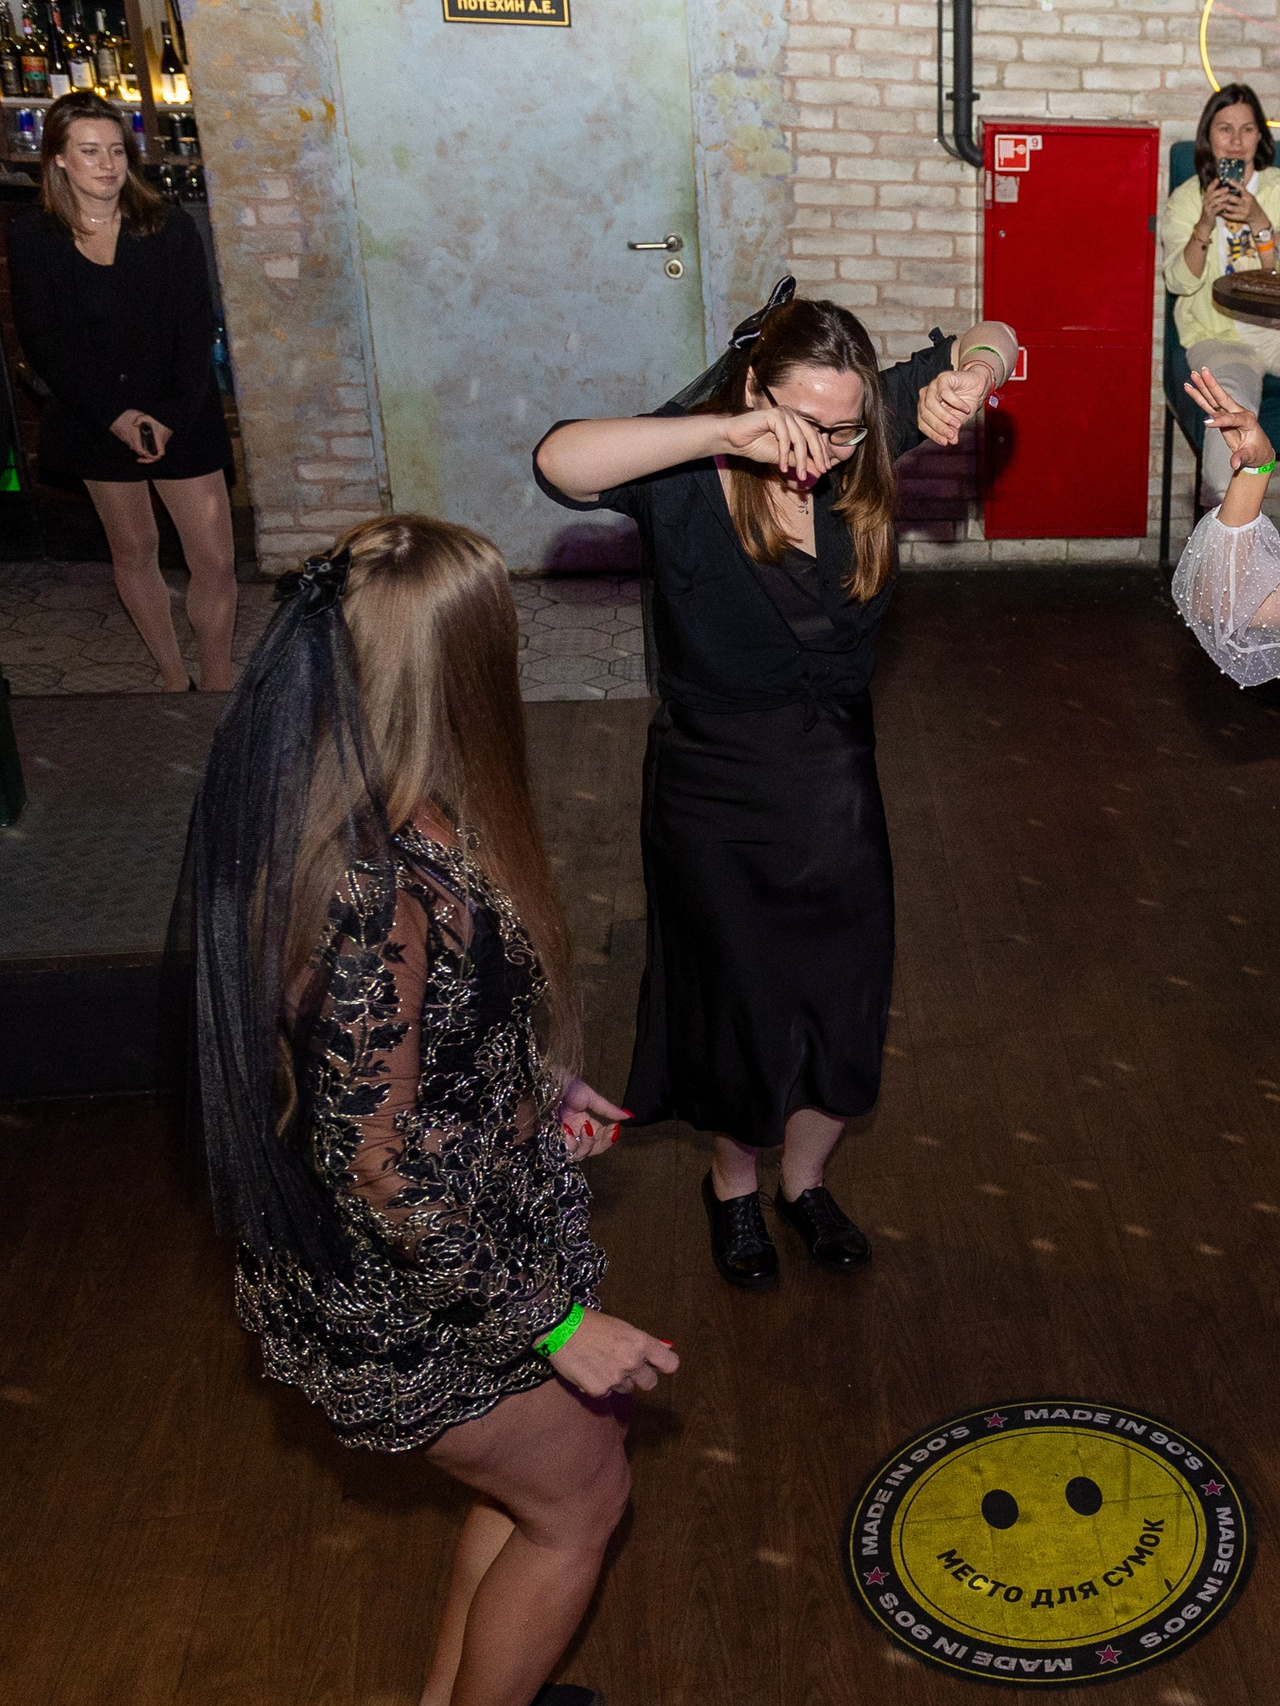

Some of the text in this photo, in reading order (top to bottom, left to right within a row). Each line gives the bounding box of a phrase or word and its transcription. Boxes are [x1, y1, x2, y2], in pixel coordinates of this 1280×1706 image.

[457, 0, 525, 12] ПОТЕХИН
[1024, 1408, 1203, 1471] MADE IN 90'S
[862, 1426, 970, 1555] MADE IN 90'S
[936, 1517, 1165, 1608] МЕСТО ДЛЯ СУМОК
[1139, 1506, 1235, 1648] MADE IN 90'S
[879, 1592, 1073, 1673] MADE IN 90'S
